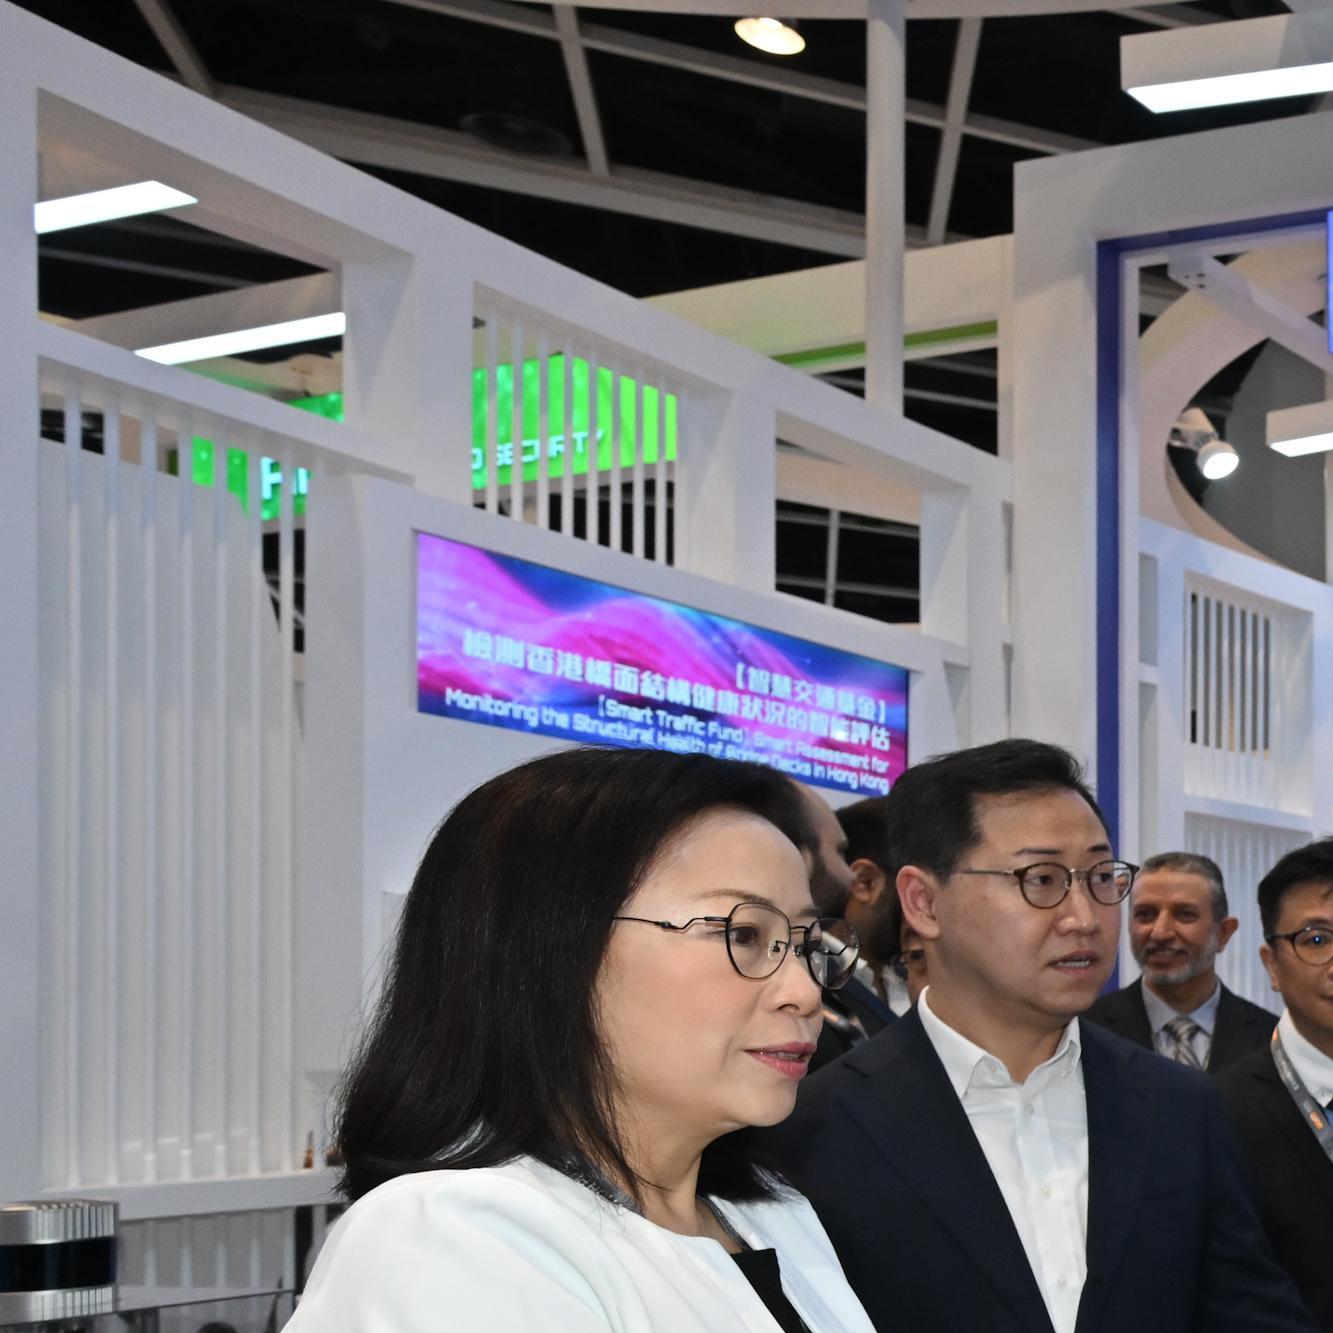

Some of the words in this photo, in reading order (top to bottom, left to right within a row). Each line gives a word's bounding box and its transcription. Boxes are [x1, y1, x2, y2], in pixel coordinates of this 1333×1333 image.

[445, 687, 538, 728] Monitoring
[541, 706, 569, 729] the
[572, 714, 655, 746] Structural
[827, 767, 859, 789] Hong
[860, 772, 890, 796] Kong
[656, 710, 706, 736] Traffic
[754, 732, 794, 753] Smart
[872, 756, 890, 773] for
